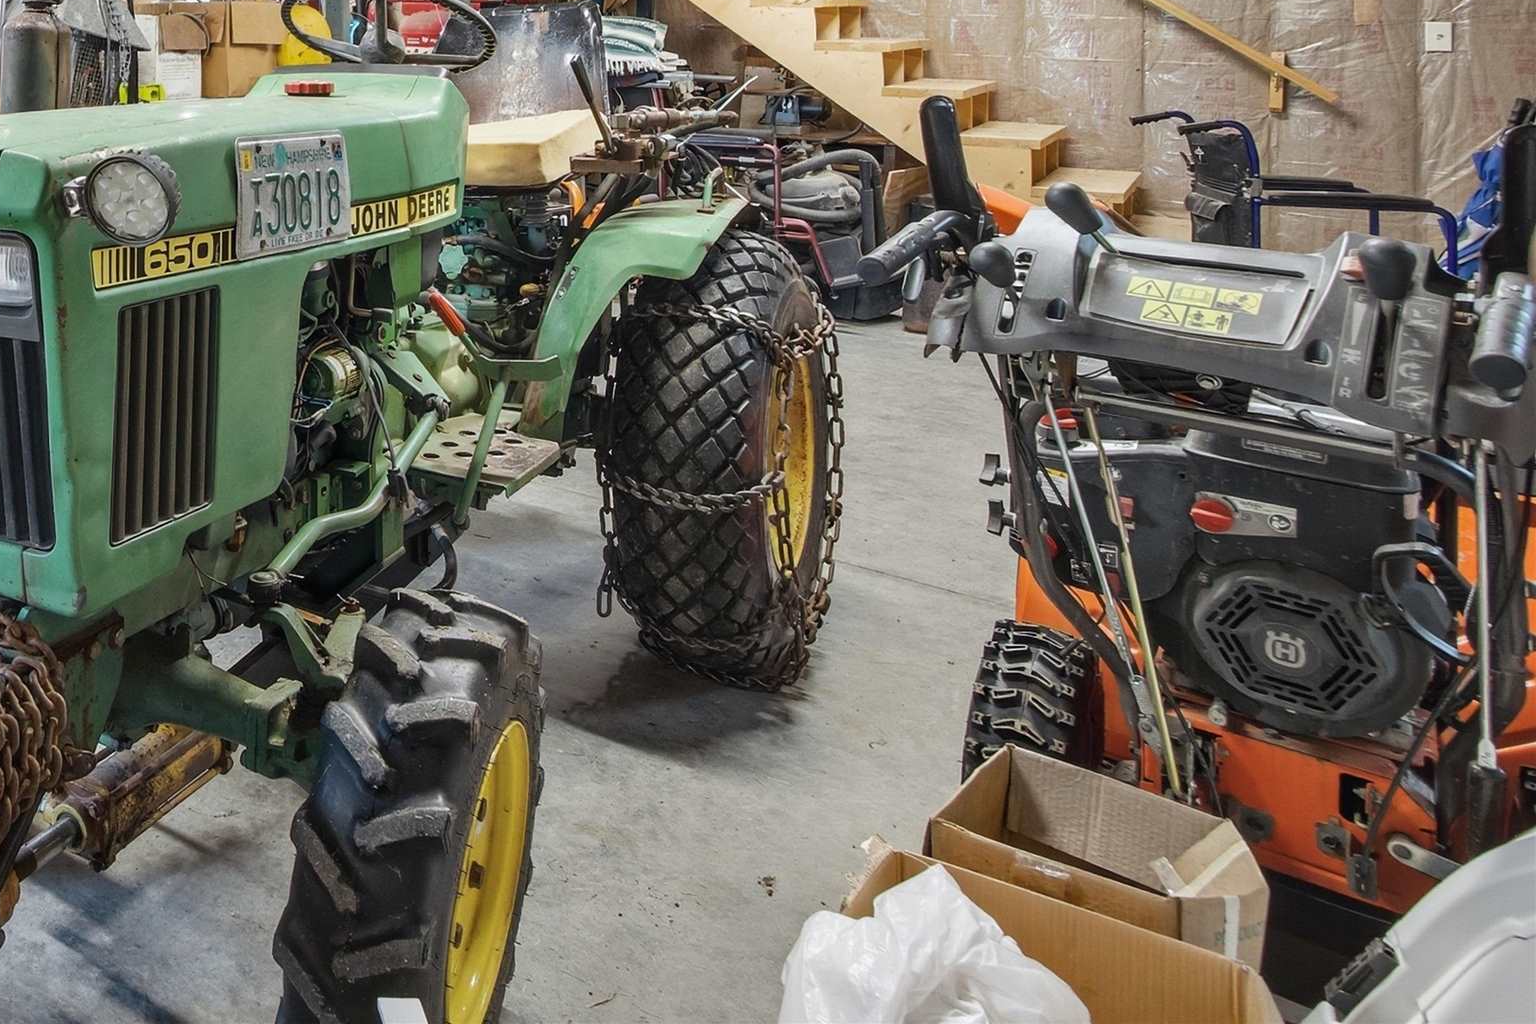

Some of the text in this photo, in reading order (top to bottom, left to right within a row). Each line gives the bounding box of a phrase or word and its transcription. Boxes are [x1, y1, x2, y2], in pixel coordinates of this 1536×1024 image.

[254, 147, 332, 169] NEW HAMPSHIRE
[144, 187, 450, 277] 650 JOHN DEERE
[265, 167, 341, 236] 30818
